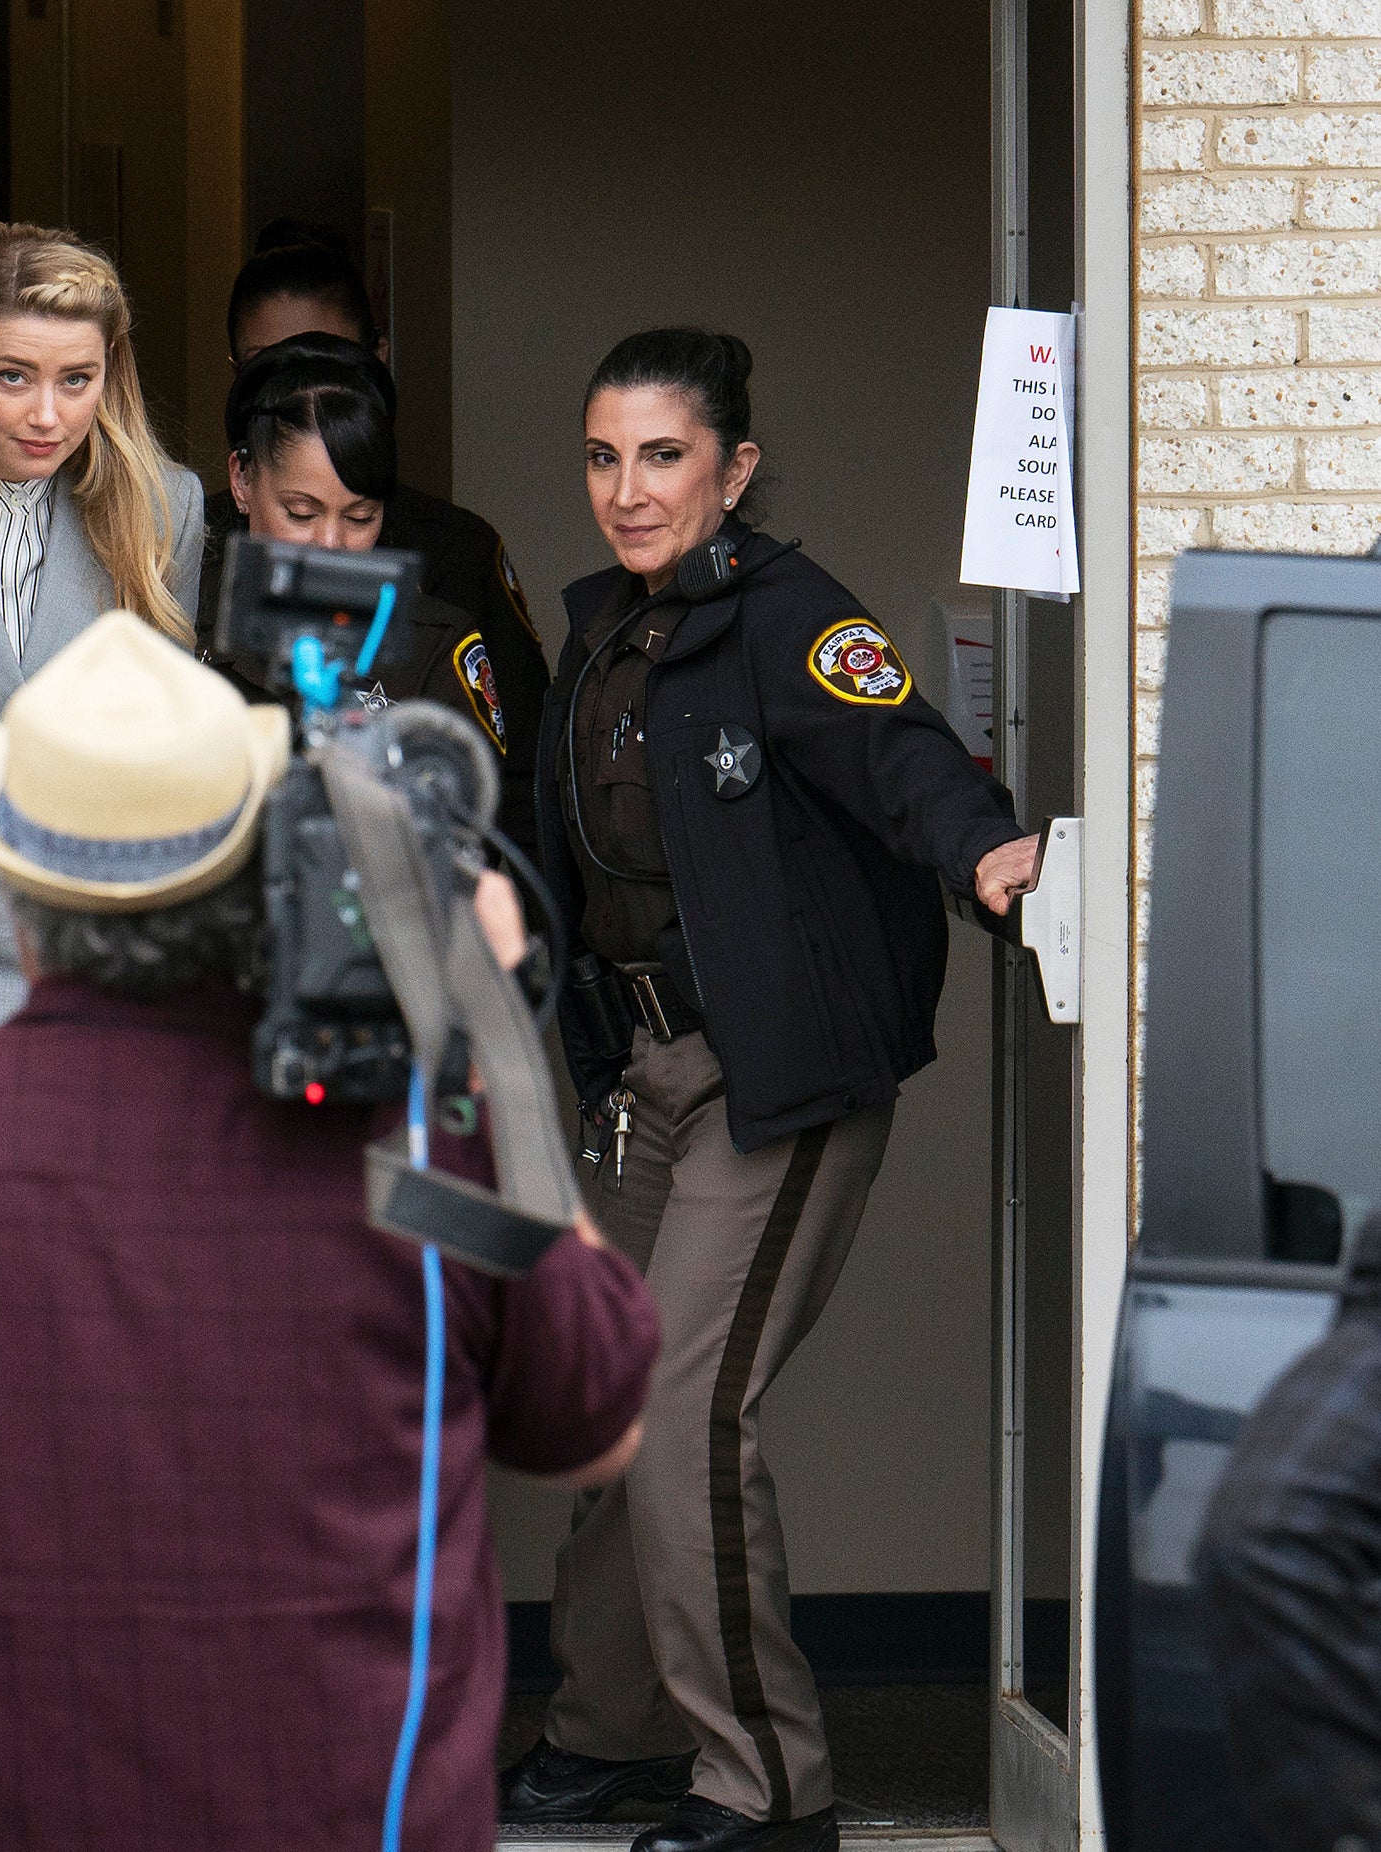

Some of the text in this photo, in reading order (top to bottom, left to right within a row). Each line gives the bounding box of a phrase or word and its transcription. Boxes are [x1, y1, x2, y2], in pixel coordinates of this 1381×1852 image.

[1030, 345, 1056, 364] W
[1013, 379, 1047, 395] THIS
[1032, 406, 1056, 421] DO
[1000, 486, 1055, 503] PLEASE
[1015, 513, 1057, 528] CARD
[823, 628, 865, 656] FAIRFAX
